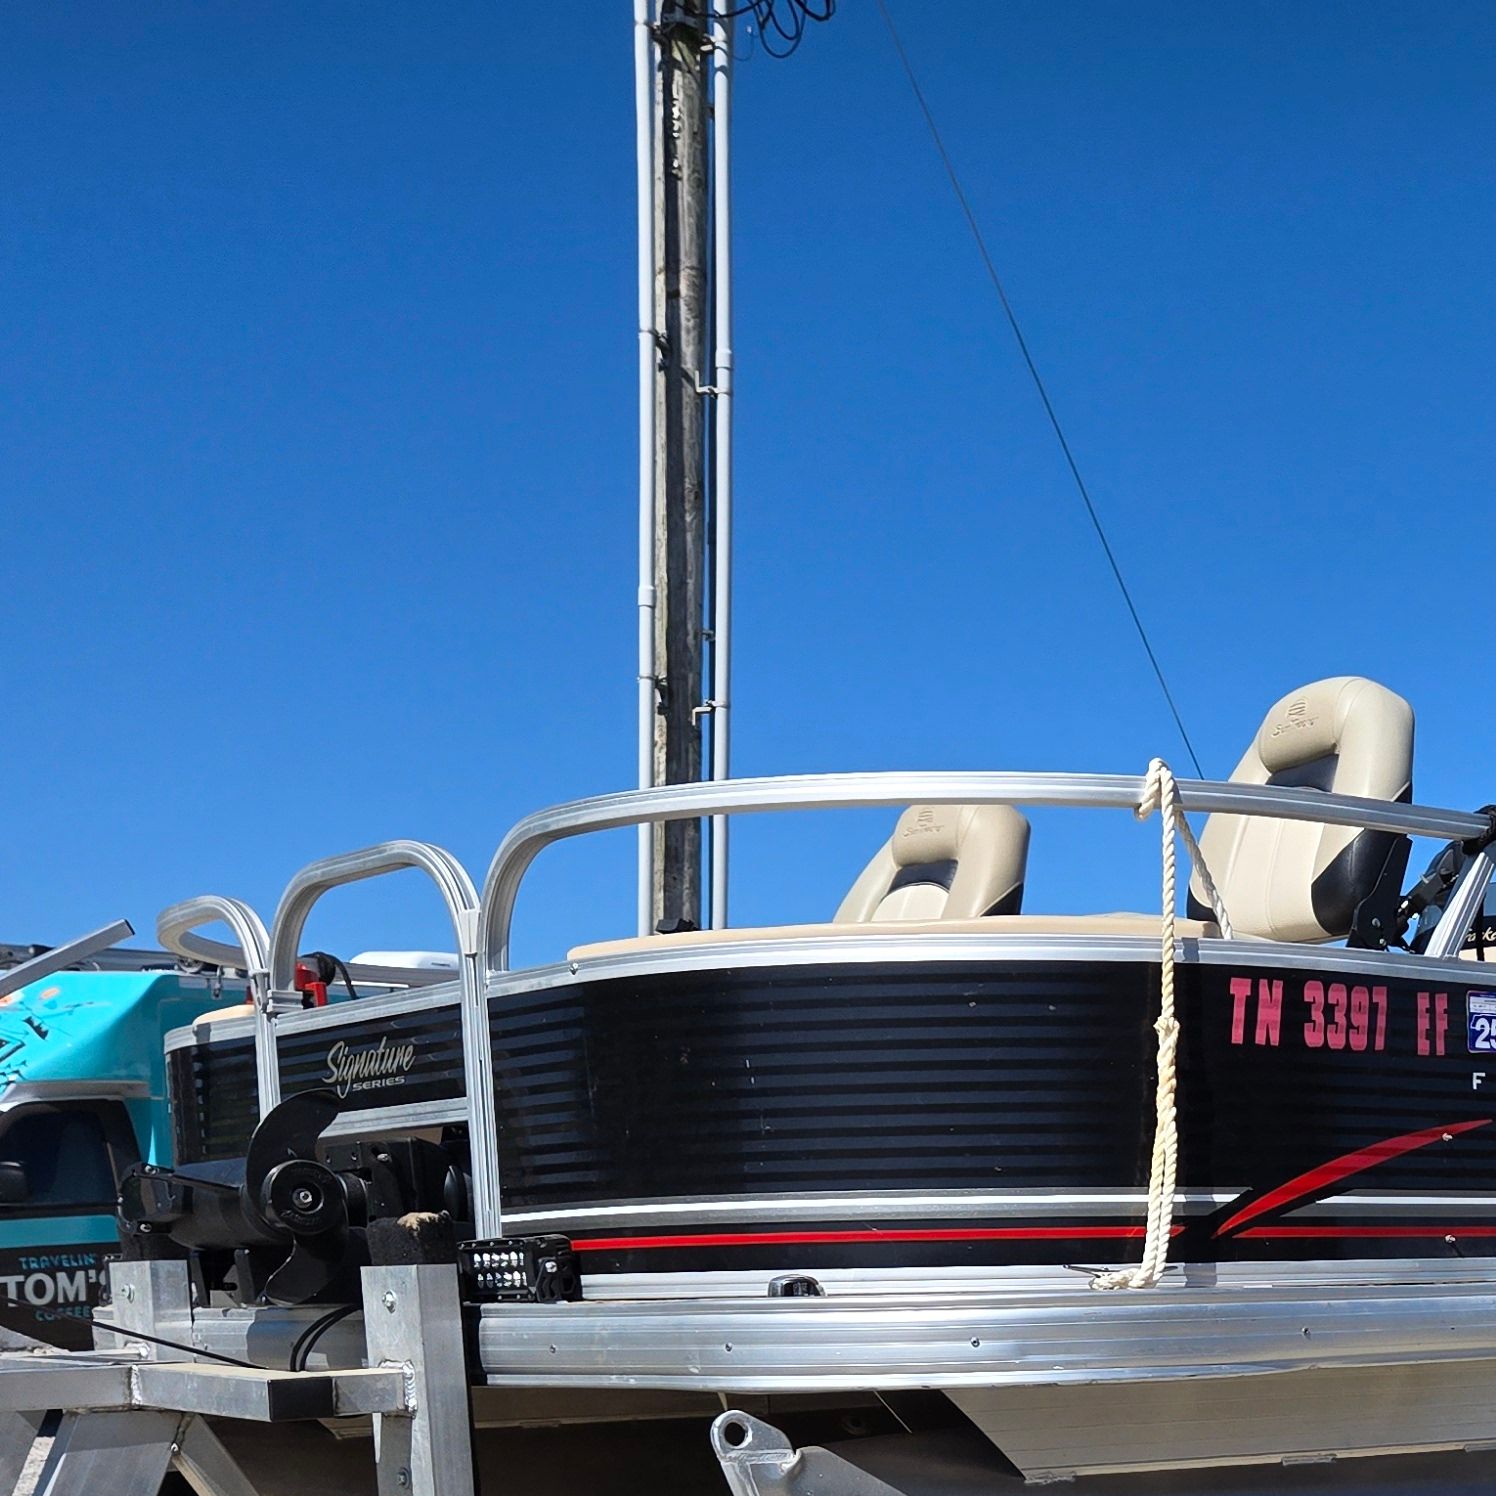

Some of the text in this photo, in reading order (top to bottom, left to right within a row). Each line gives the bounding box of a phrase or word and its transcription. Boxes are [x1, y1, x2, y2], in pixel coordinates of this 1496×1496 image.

[1230, 977, 1284, 1047] TN
[1303, 980, 1388, 1051] 3397
[321, 1036, 416, 1099] Signature
[352, 1075, 405, 1092] SERIES
[0, 1269, 106, 1308] TOM'
